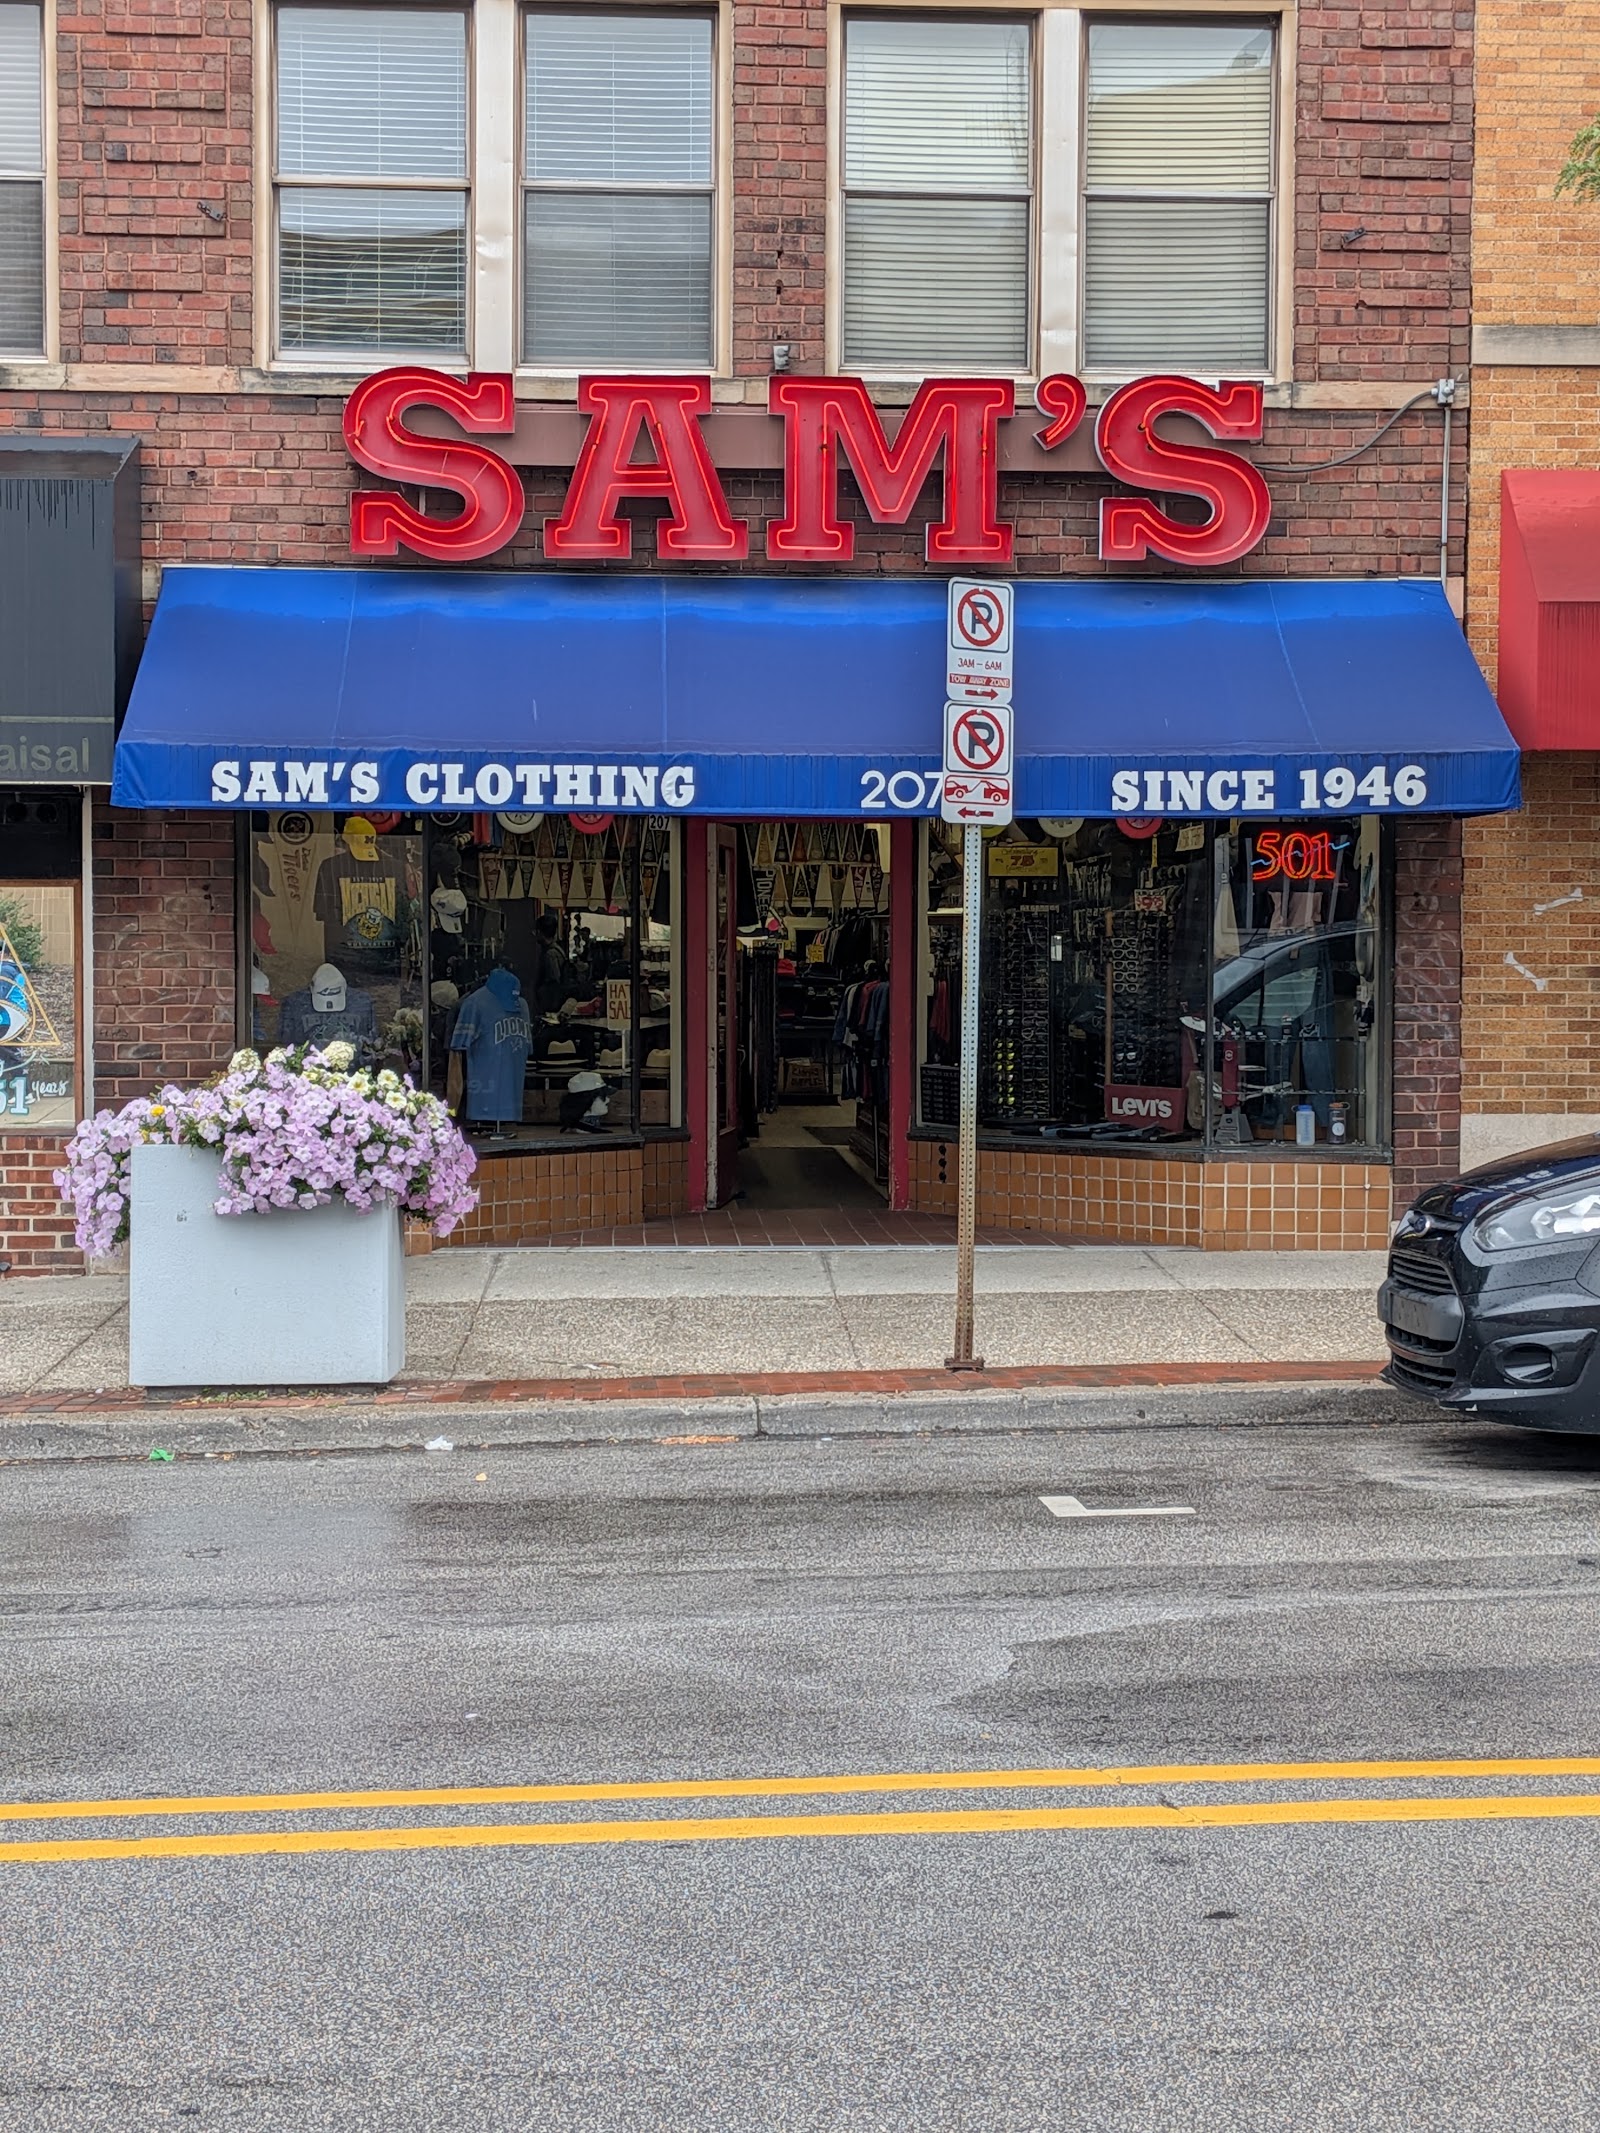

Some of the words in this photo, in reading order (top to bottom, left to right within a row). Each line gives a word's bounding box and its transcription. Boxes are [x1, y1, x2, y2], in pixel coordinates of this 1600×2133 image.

[343, 367, 1272, 567] SAM'S
[950, 674, 967, 684] TOW
[958, 657, 975, 669] 3AM
[984, 663, 1002, 671] 6AM
[211, 761, 380, 804] SAM'S
[406, 763, 696, 808] CLOTHING
[860, 769, 943, 809] 207
[1112, 770, 1275, 812] SINCE
[1299, 765, 1427, 808] 1946
[650, 815, 669, 830] 207
[1252, 832, 1336, 881] 501
[609, 1001, 631, 1020] SAL
[31, 1080, 69, 1102] years
